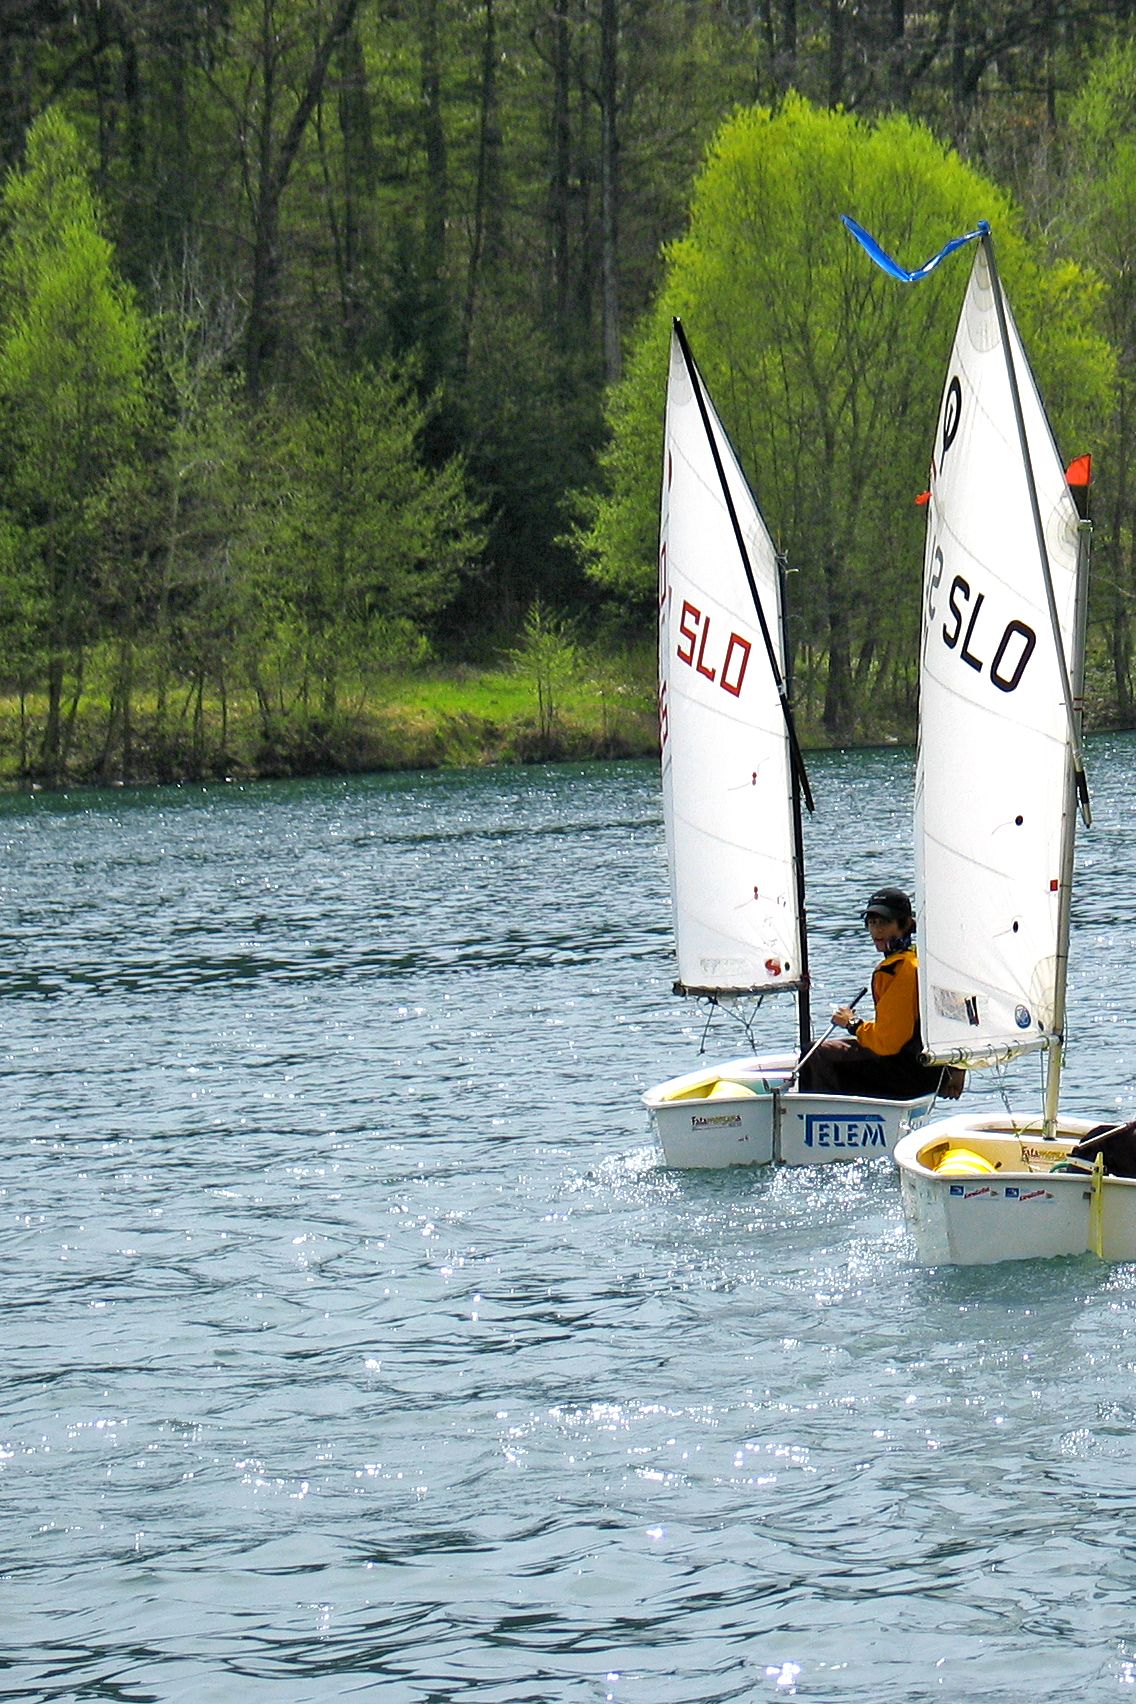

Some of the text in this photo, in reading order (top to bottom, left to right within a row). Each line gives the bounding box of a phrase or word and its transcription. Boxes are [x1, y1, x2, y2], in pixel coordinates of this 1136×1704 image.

[677, 599, 752, 698] SLO
[942, 574, 1036, 693] SLO
[797, 1114, 887, 1148] TELEM
